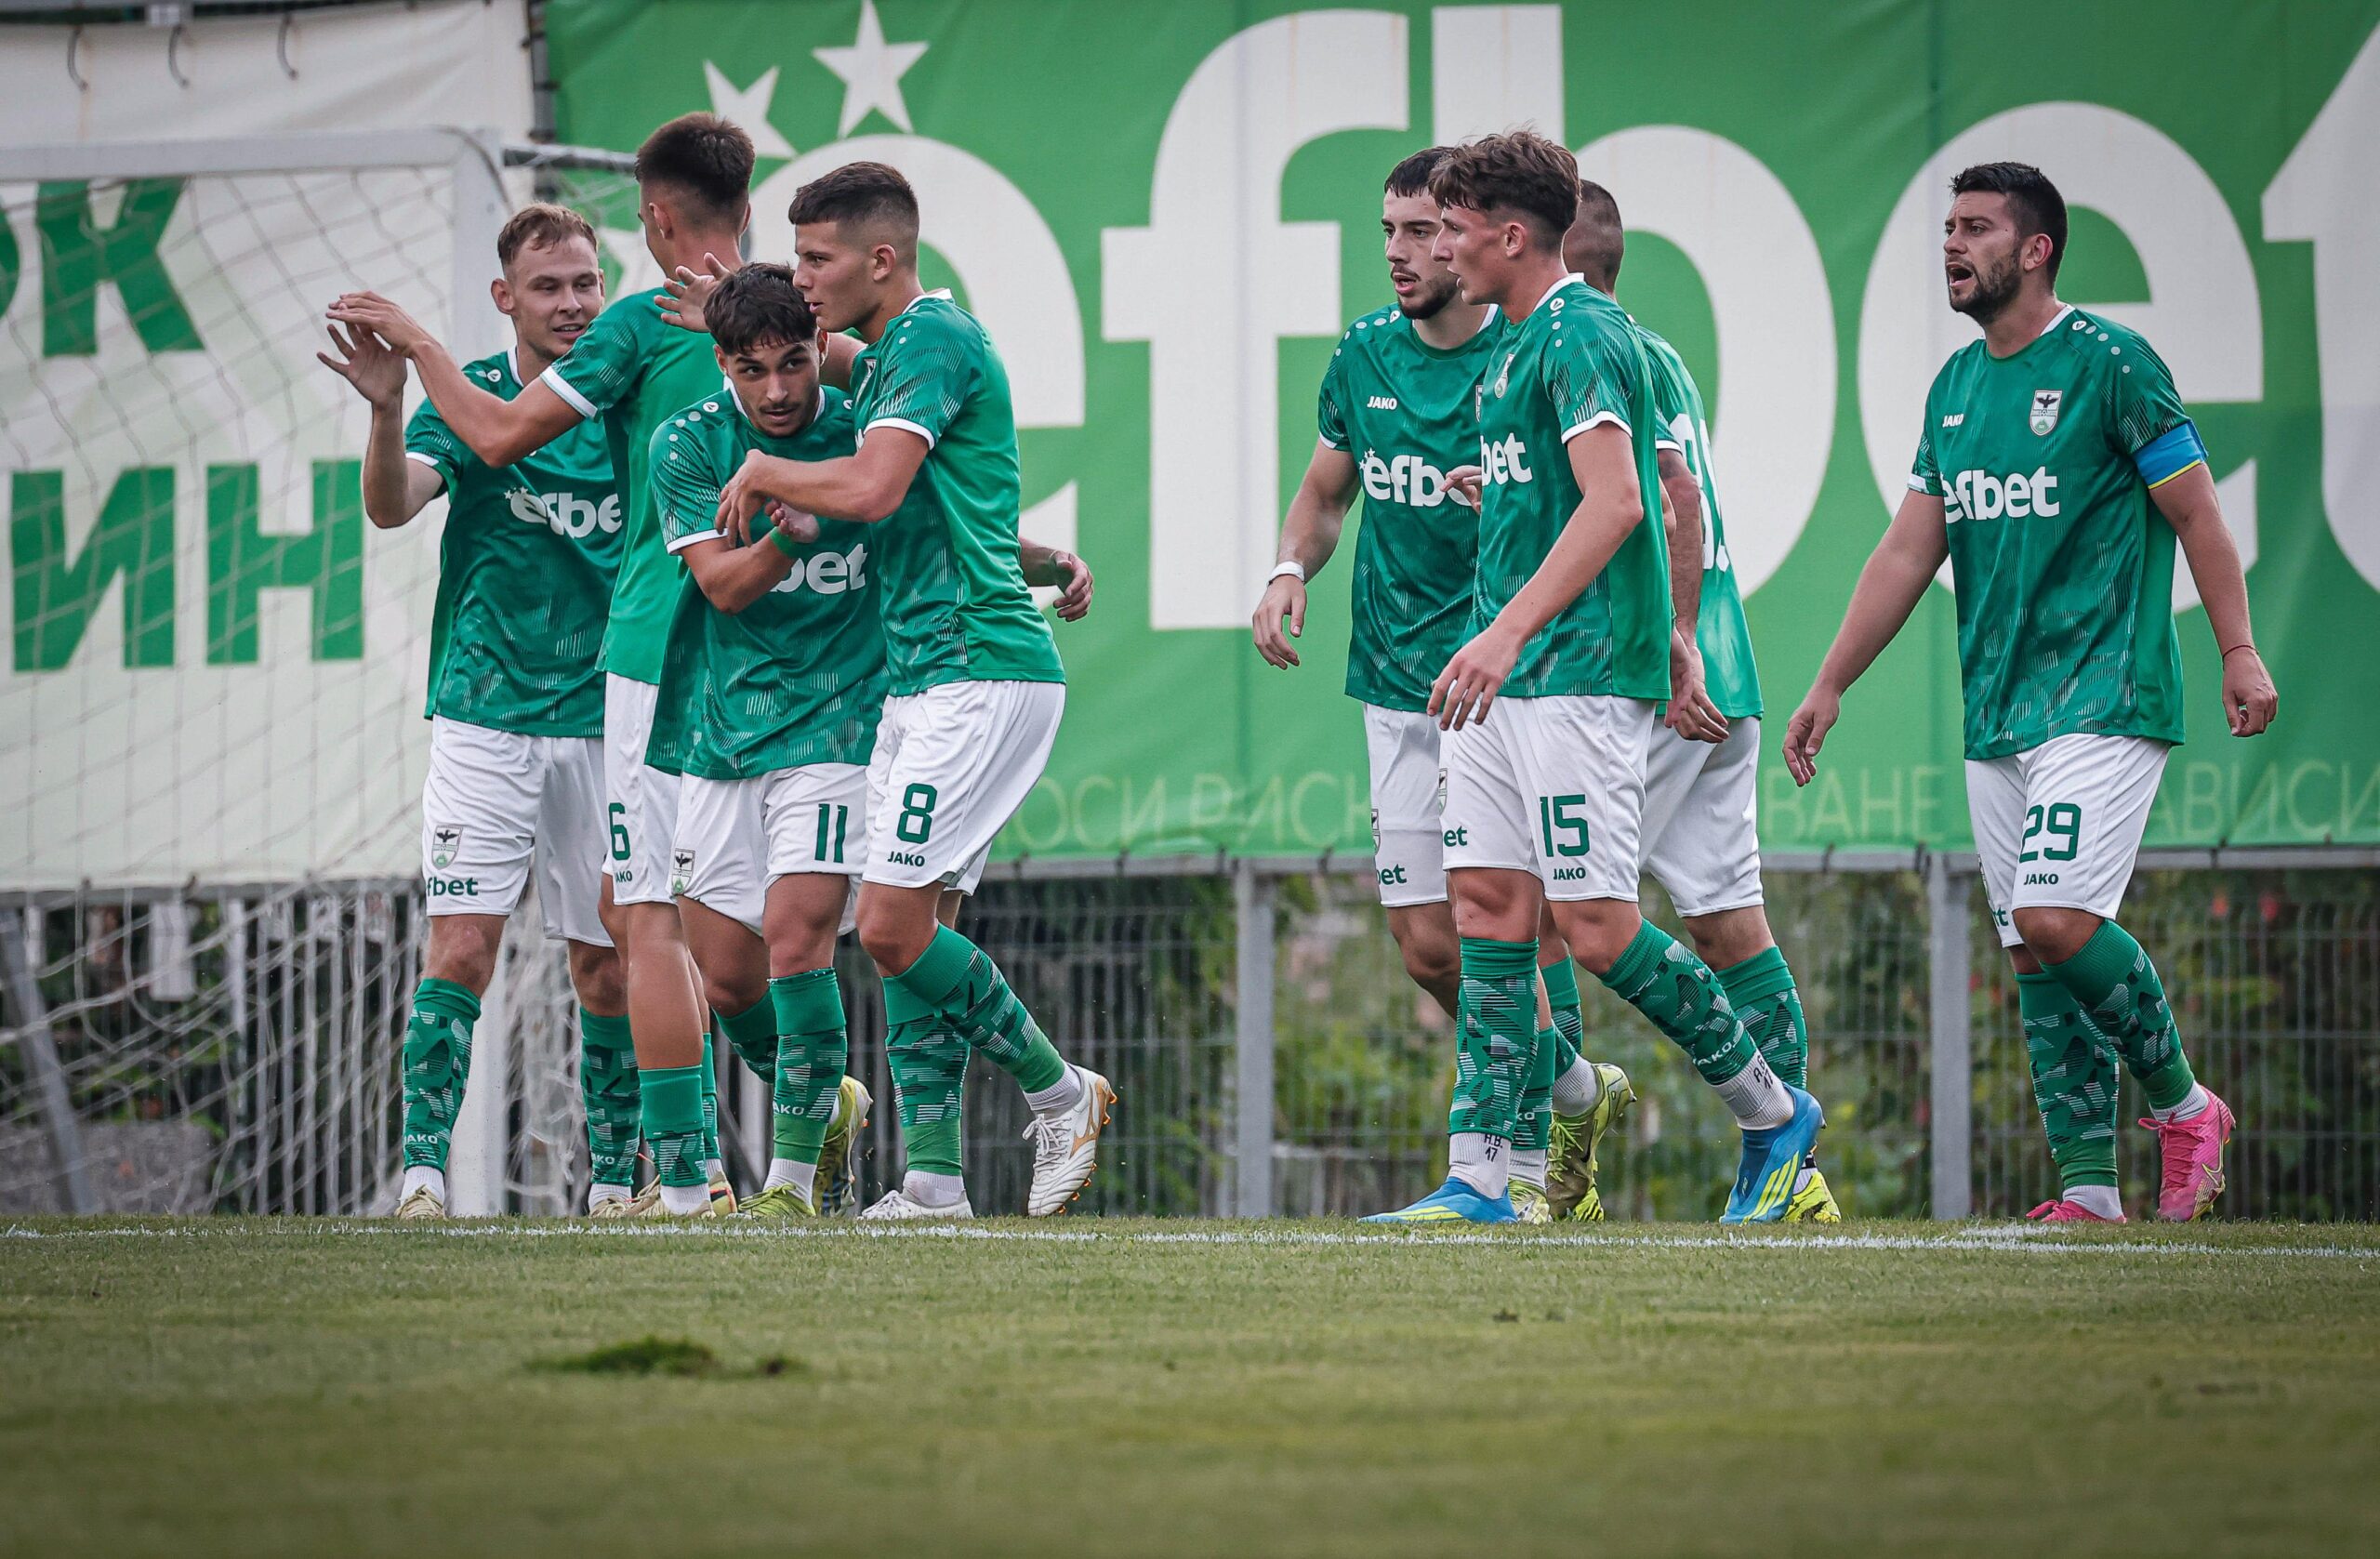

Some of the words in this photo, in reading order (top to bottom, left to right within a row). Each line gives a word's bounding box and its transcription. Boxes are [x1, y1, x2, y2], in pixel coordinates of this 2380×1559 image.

[0, 176, 205, 357] К
[1367, 396, 1397, 410] JAKO
[1942, 414, 1964, 428] JAKO
[1480, 432, 1533, 487] bet
[1940, 466, 2060, 523] efbet
[10, 458, 364, 671] ИН
[608, 802, 630, 861] 6
[814, 803, 848, 864] 11
[896, 783, 937, 844] 8
[999, 774, 1168, 850] ОСИ
[1540, 794, 1590, 857] 15
[2019, 802, 2082, 864] 29
[427, 877, 478, 896] fbet
[615, 870, 632, 883] AKO
[888, 851, 925, 867] JAKO
[1553, 867, 1586, 880] JAKO
[2024, 874, 2058, 885] JAKO
[407, 1134, 438, 1144] AKO
